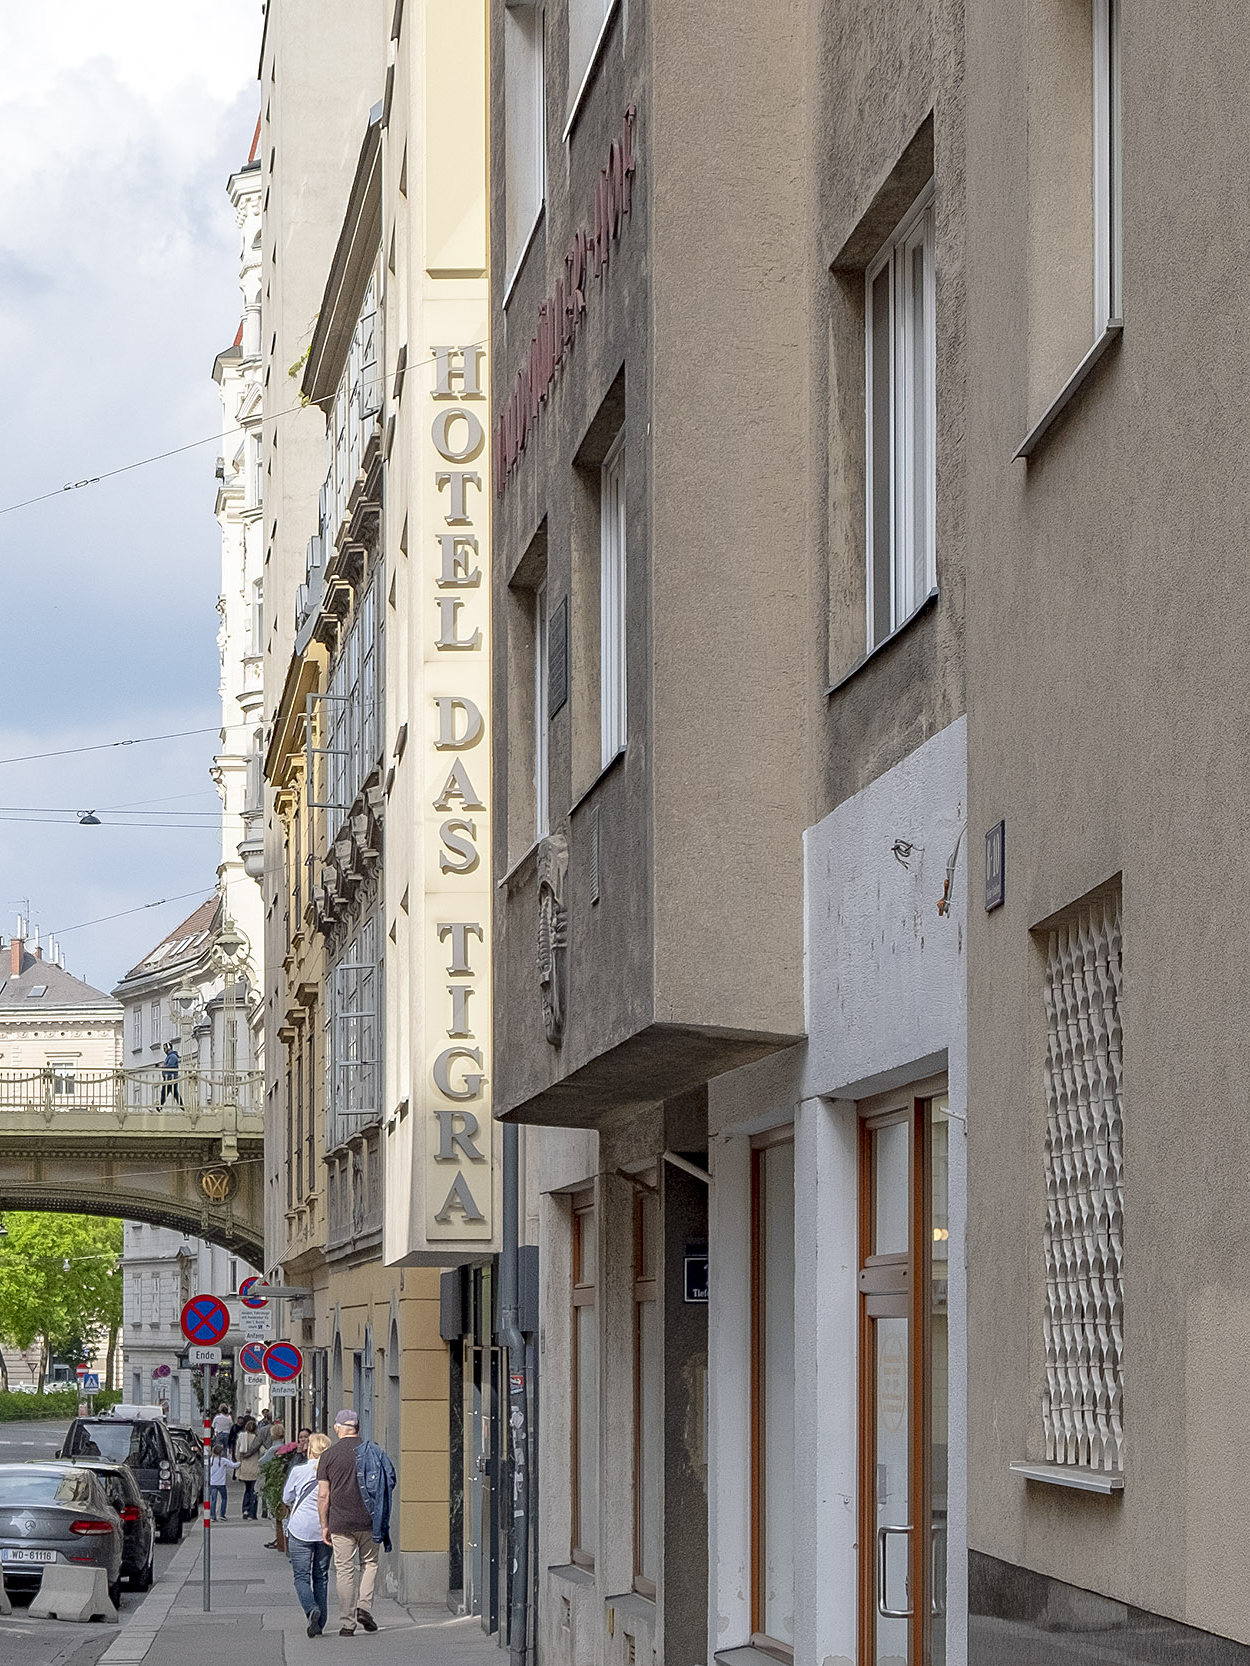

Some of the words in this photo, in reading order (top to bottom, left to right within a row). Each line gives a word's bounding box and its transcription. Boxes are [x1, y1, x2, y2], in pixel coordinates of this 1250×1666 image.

[430, 346, 485, 650] HOTEL
[432, 696, 486, 876] DAS
[433, 922, 486, 1222] TIGRA
[271, 1386, 295, 1394] Anfang
